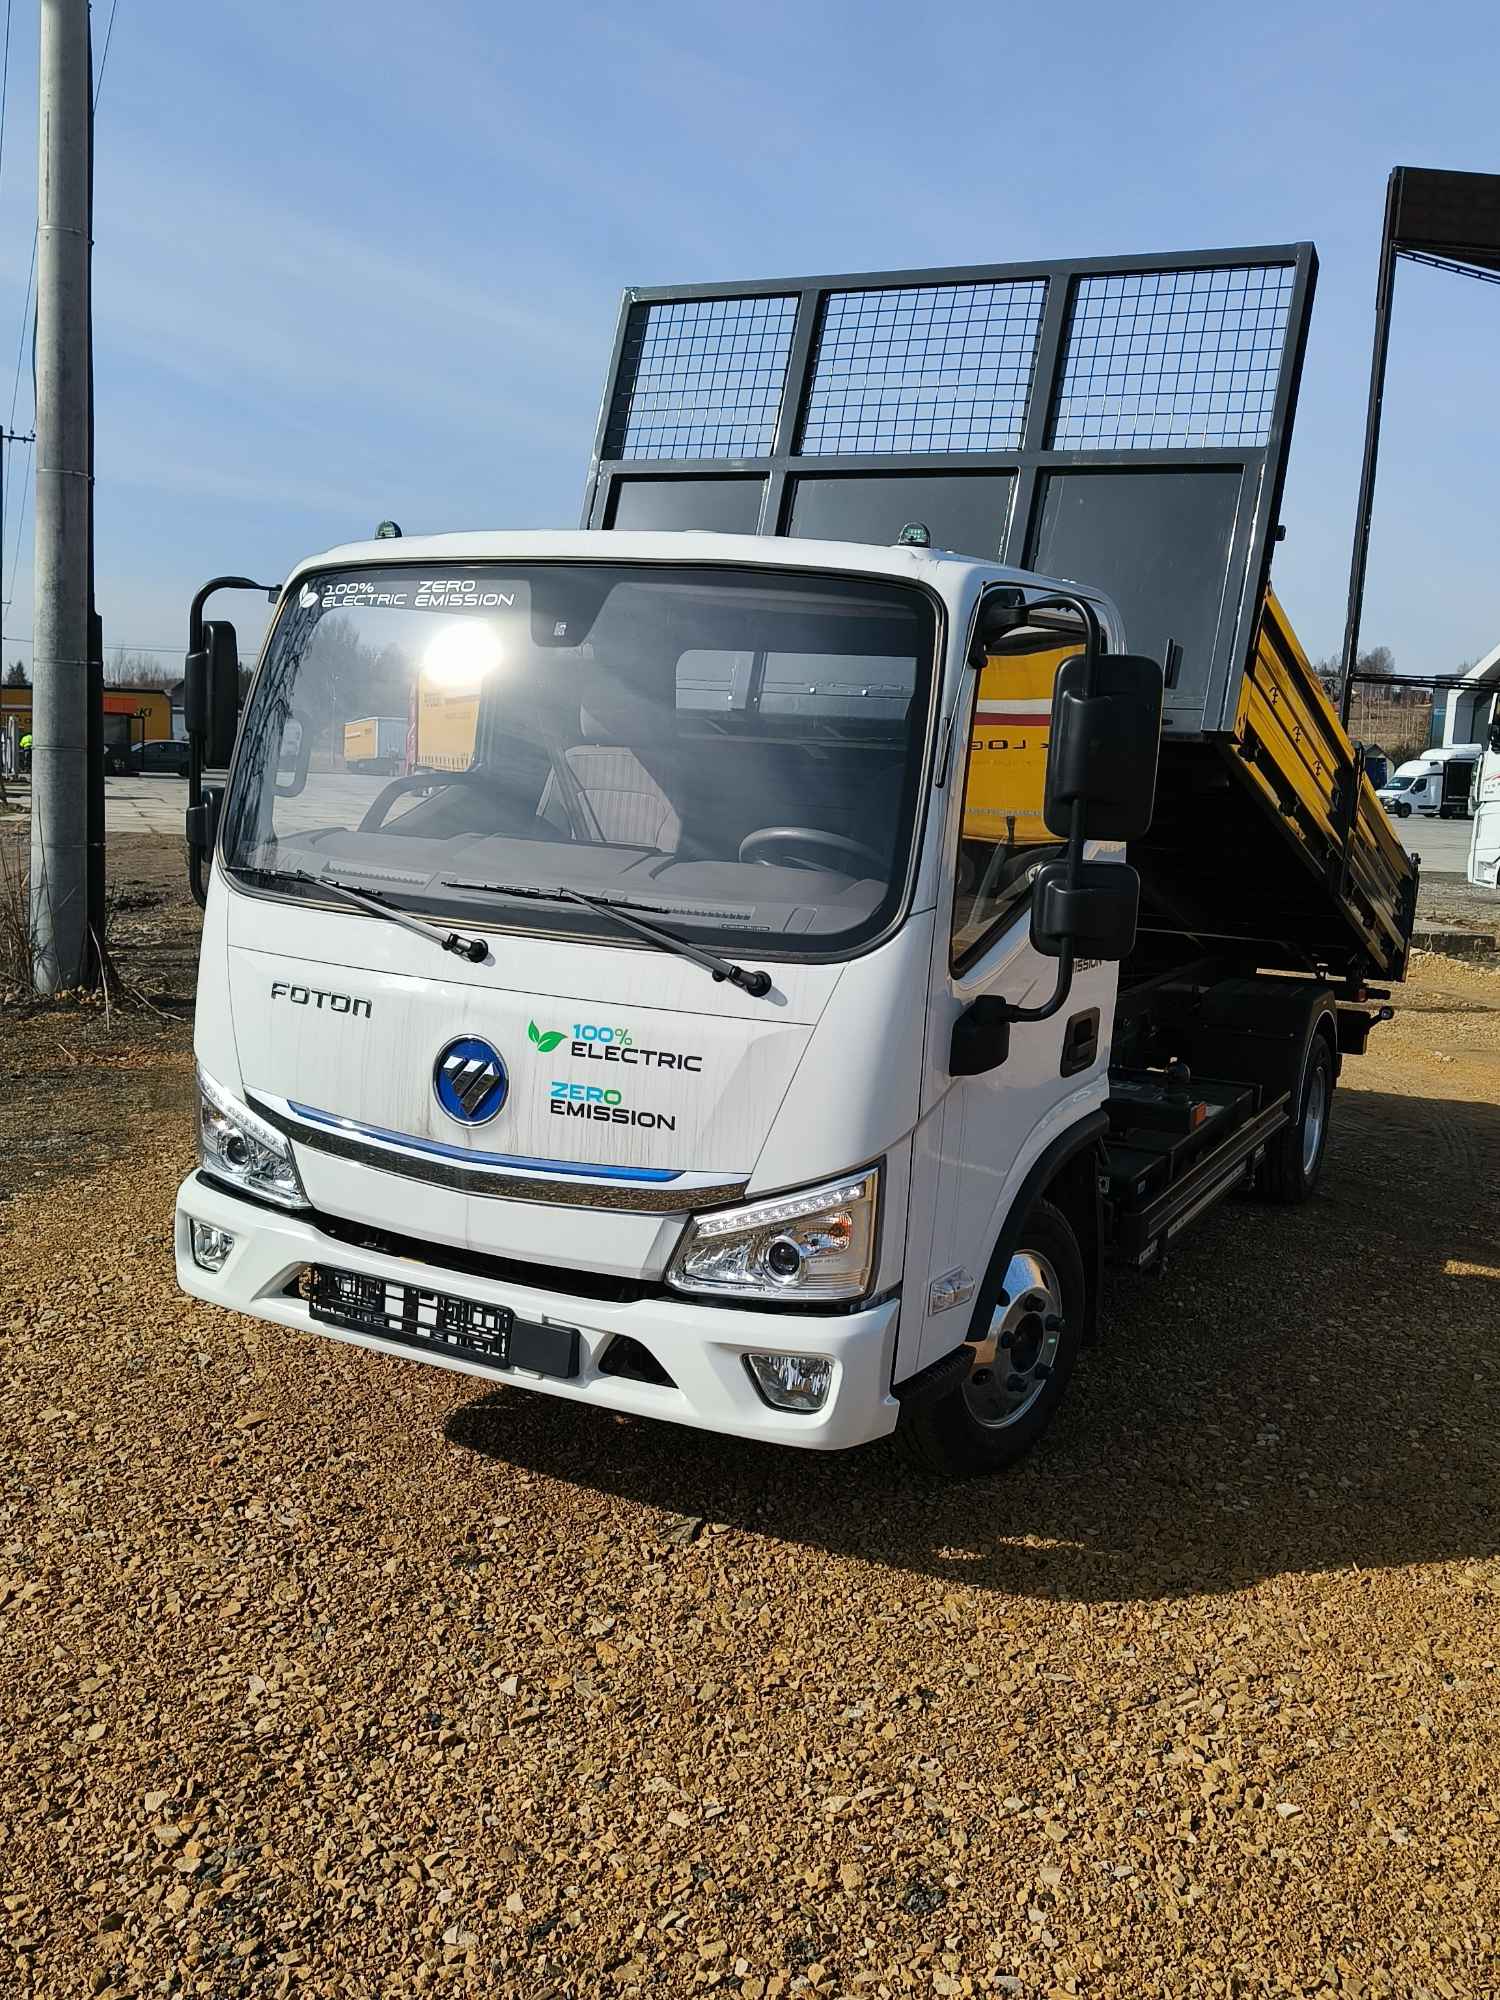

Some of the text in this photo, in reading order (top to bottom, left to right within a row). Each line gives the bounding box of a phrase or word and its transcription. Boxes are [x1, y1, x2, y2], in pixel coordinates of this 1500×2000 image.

[324, 582, 374, 595] 100%
[417, 580, 476, 593] ZERO
[321, 593, 407, 608] ELECTRIC
[414, 593, 515, 607] EMISSION
[271, 982, 373, 1018] FOTON
[572, 1023, 633, 1046] 100%
[571, 1041, 704, 1072] ELECTRIC
[550, 1081, 622, 1106] ZERO
[550, 1100, 677, 1131] EMISSION
